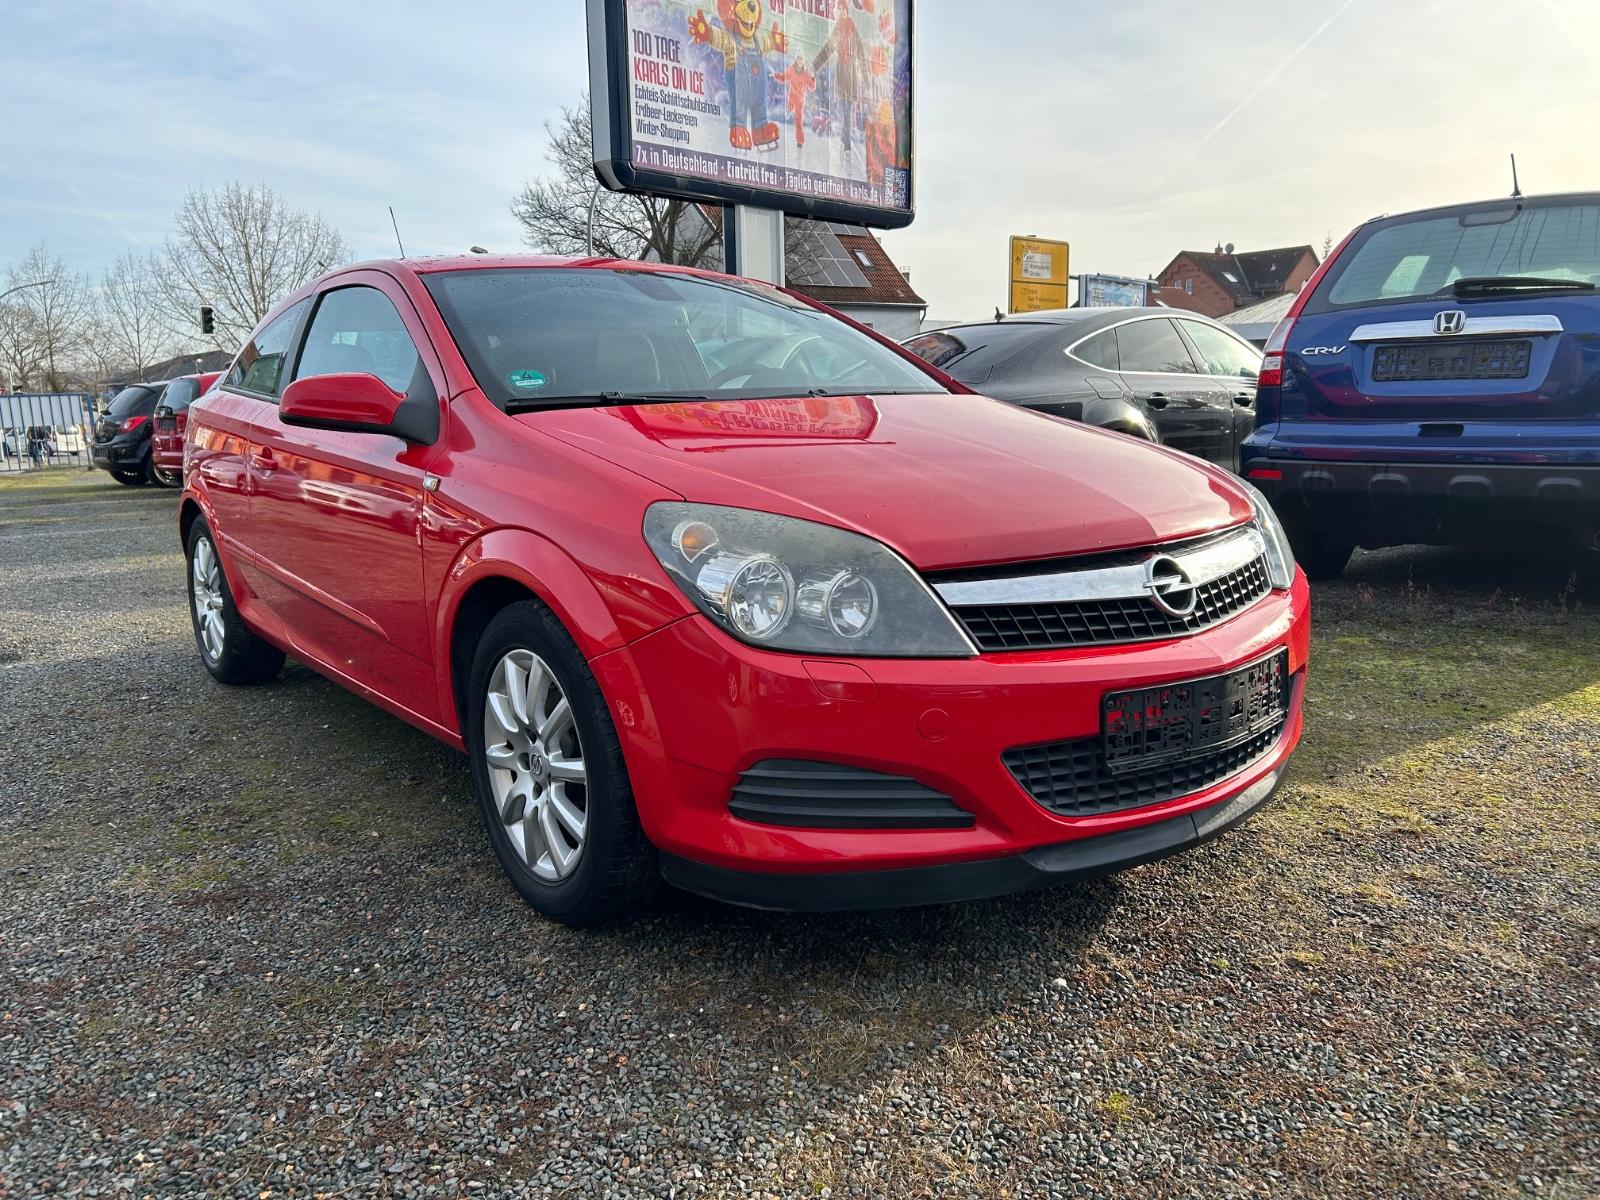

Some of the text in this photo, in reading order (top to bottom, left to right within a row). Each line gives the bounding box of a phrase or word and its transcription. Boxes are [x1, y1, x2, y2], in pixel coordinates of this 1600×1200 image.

[632, 29, 681, 63] 100 TAGE
[633, 56, 704, 95] KARLS ON ICE
[634, 84, 721, 117] Echteis-Schlittschuhbahnen
[635, 101, 698, 128] Erdbeer-Leckereien
[635, 118, 690, 145] Winter-Shopping
[636, 145, 648, 164] 7x
[649, 147, 660, 166] in
[662, 149, 718, 176] Deutschland
[761, 168, 778, 186] frei
[785, 171, 812, 193] Täglich
[813, 179, 844, 197] geöffnet
[1301, 345, 1348, 355] CR-V
